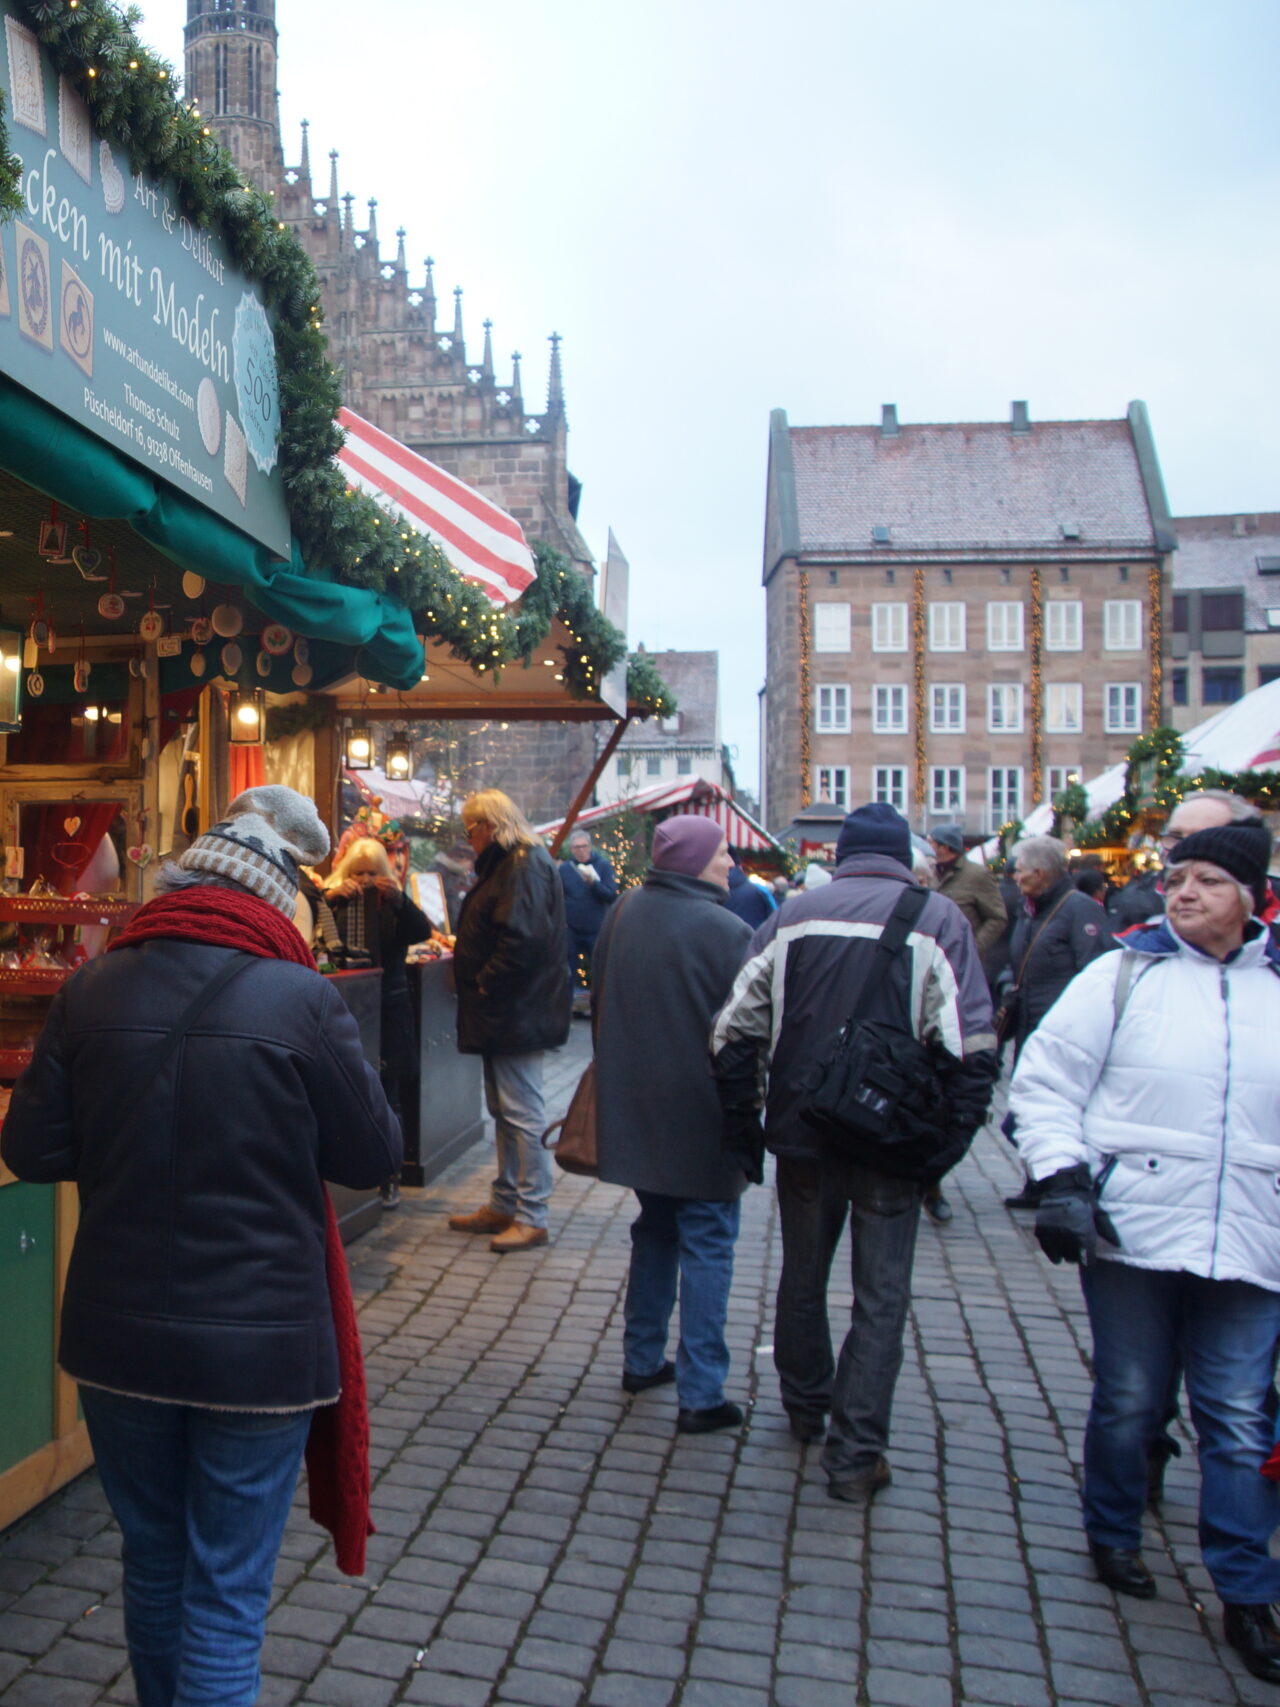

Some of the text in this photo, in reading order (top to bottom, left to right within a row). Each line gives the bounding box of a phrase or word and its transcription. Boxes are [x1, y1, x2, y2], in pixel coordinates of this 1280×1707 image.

[132, 171, 225, 286] Art & Delikat
[98, 232, 144, 306] mit
[150, 266, 230, 383] Modeln
[103, 327, 195, 412] www.artunddelikat.com
[123, 383, 180, 441] Thomas Schulz
[244, 356, 271, 422] 500
[84, 387, 213, 494] Püscheldorf 16, 91238 Offenhausen
